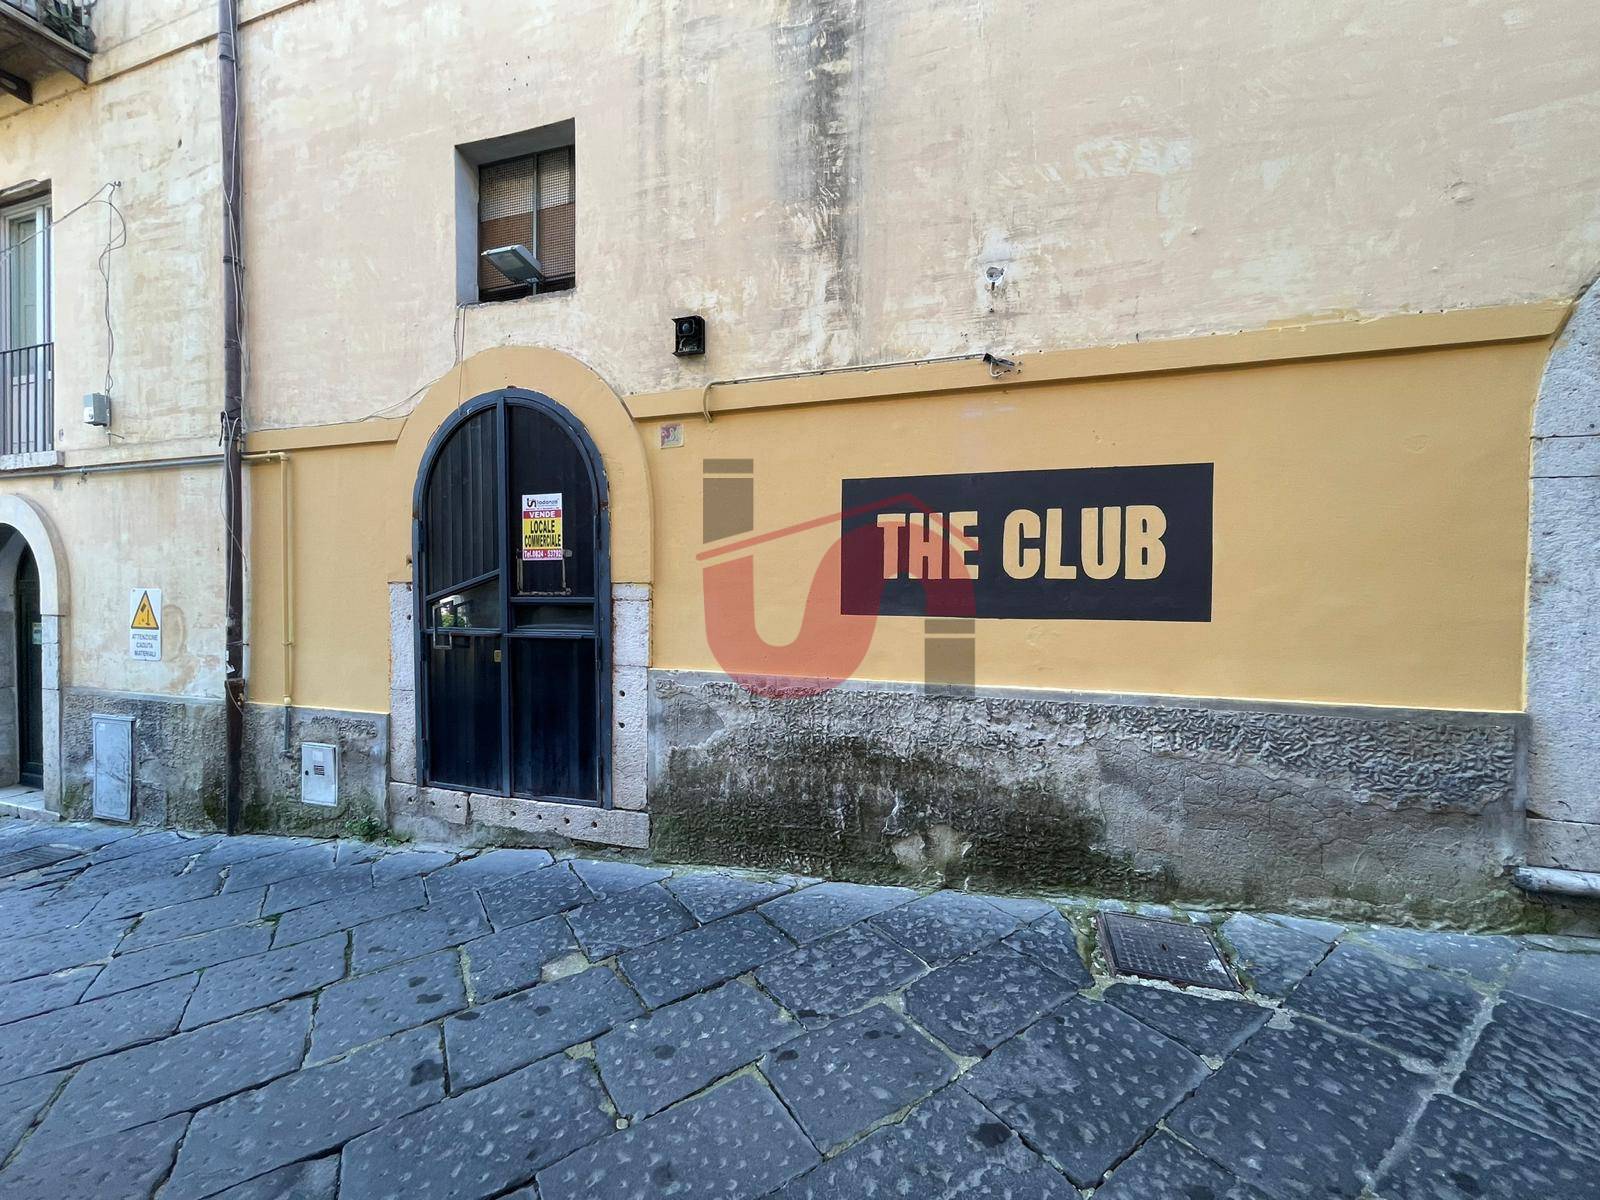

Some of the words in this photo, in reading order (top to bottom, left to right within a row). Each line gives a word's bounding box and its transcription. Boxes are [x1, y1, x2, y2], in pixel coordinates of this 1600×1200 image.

[530, 520, 555, 533] LOCALE
[525, 534, 561, 547] COMMERCIALE
[877, 511, 979, 580] THE
[1003, 505, 1167, 580] CLUB
